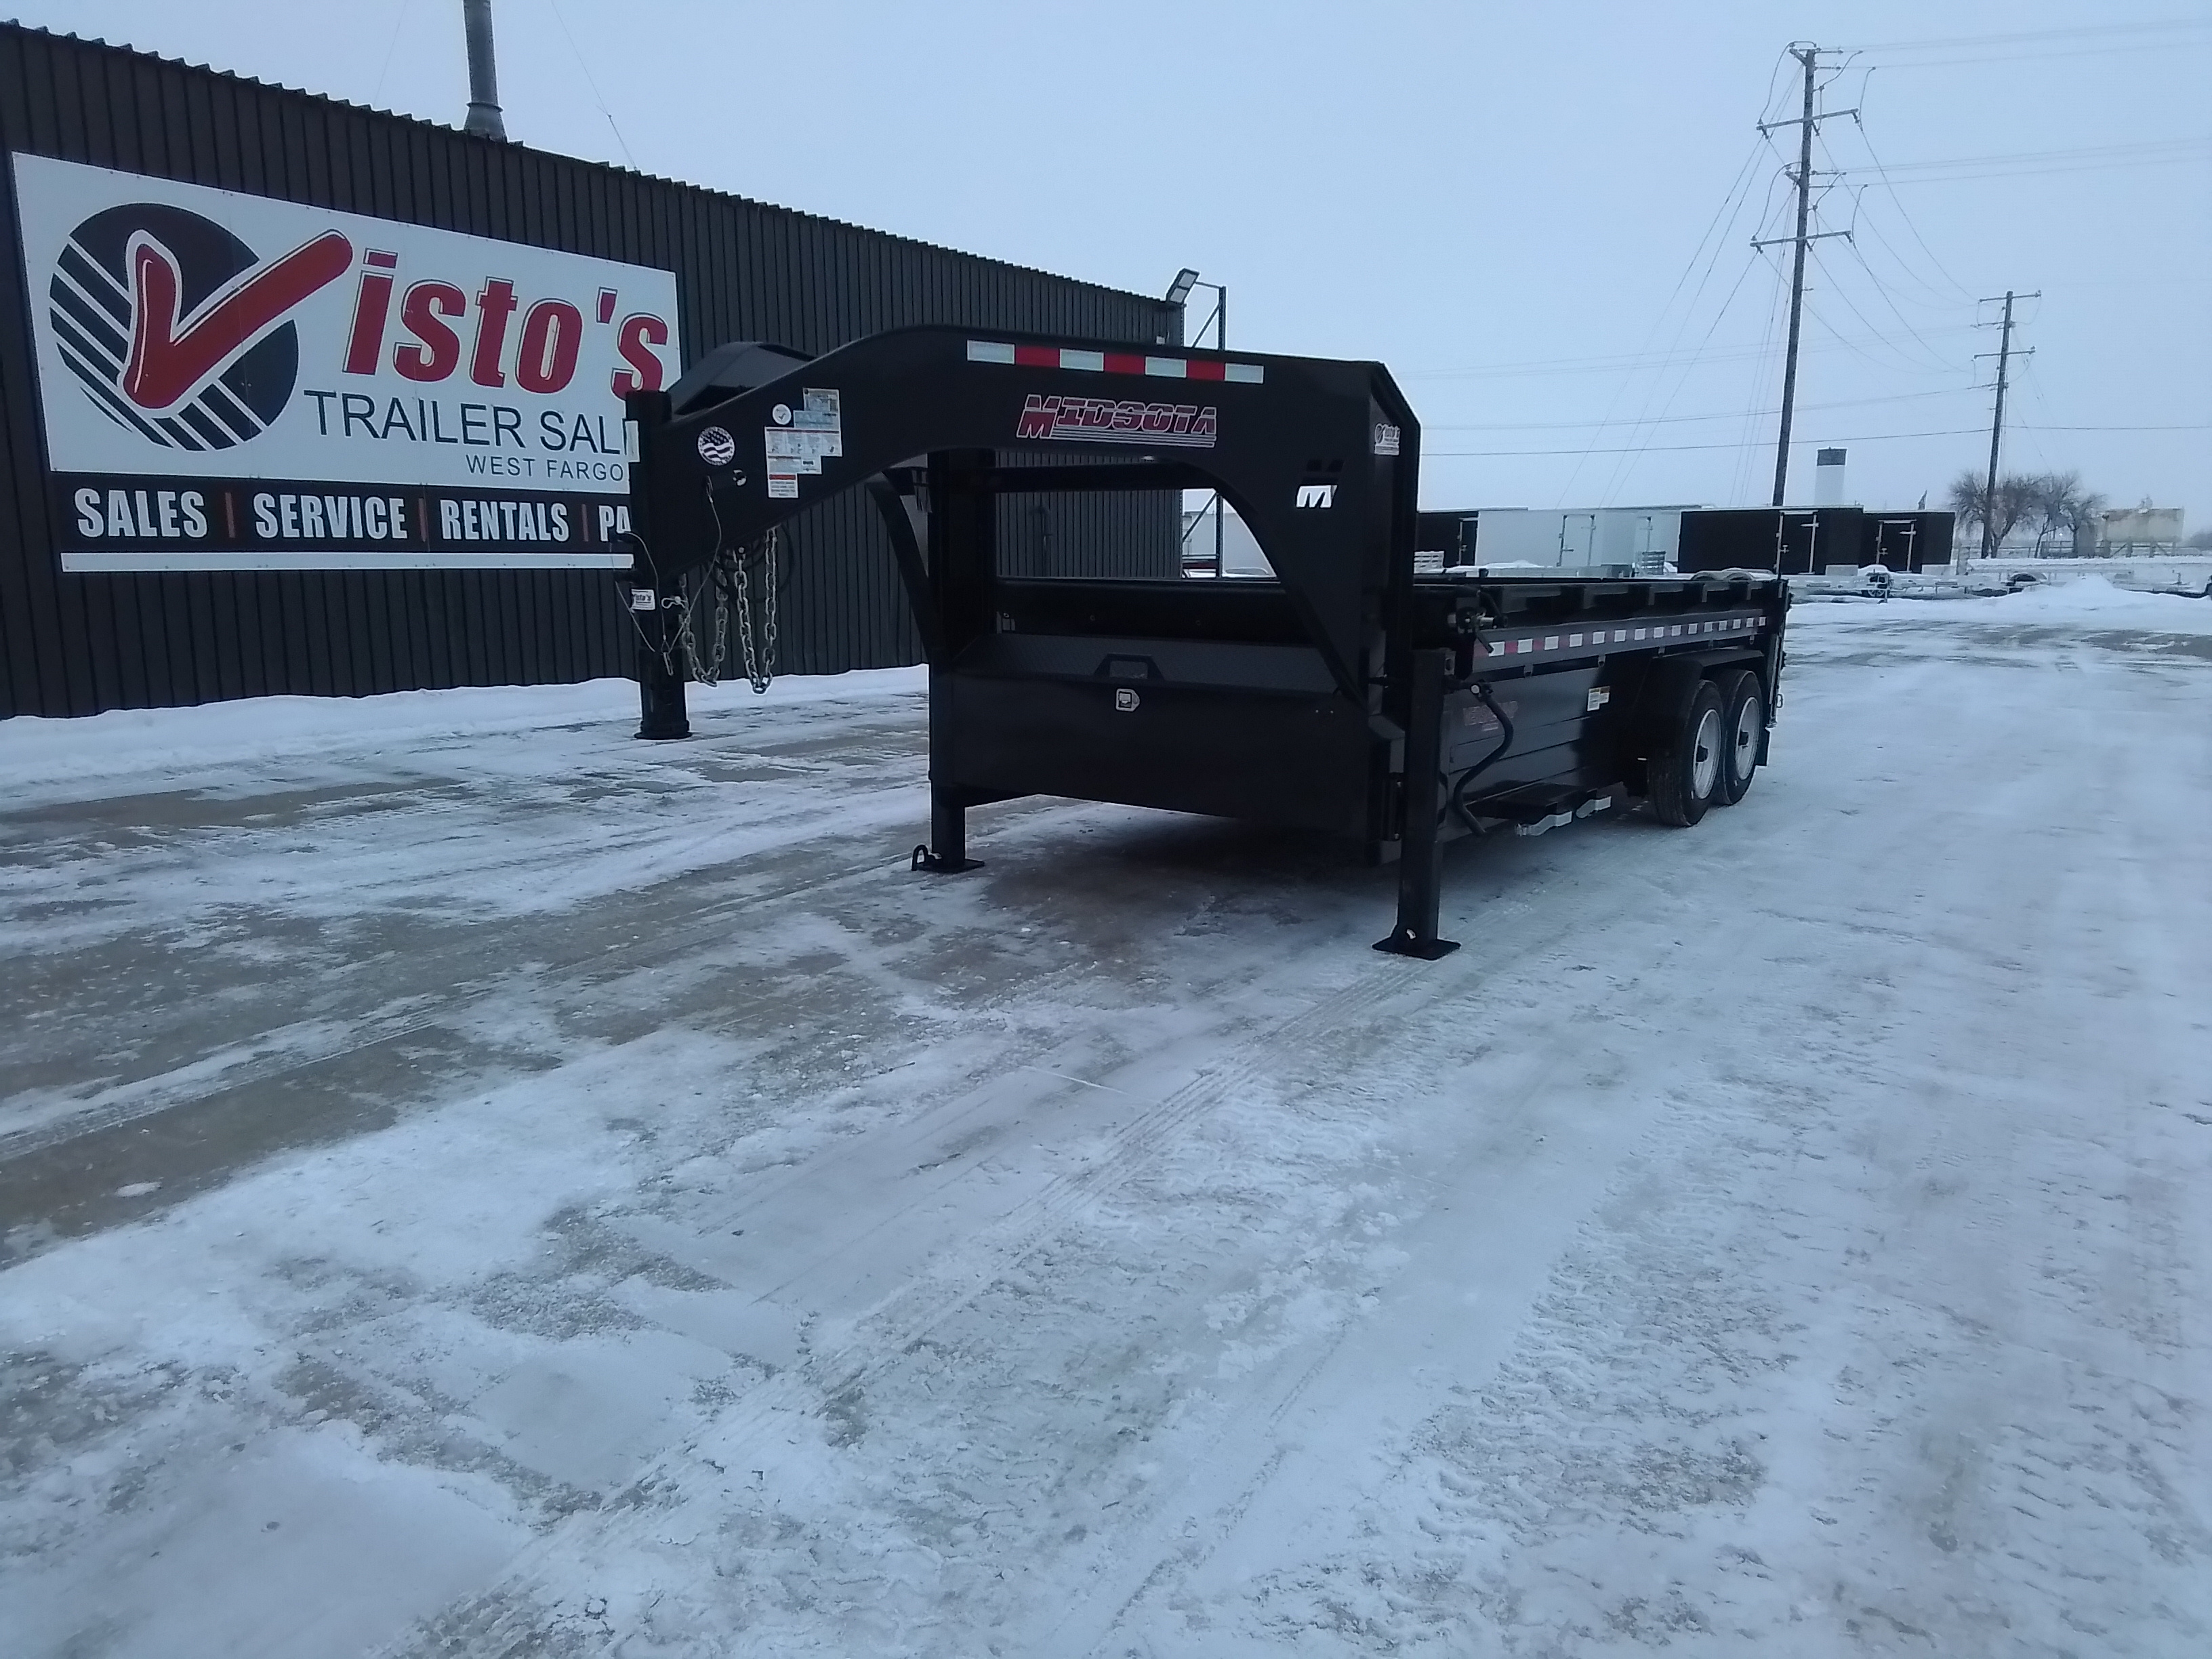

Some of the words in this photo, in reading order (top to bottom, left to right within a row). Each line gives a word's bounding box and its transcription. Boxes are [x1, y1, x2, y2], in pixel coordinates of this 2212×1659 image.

[303, 389, 526, 449] TRAILER
[1017, 394, 1217, 439] MIDSOTA
[466, 454, 536, 477] WEST
[546, 459, 624, 482] FARGO
[74, 487, 208, 539] SALES
[253, 493, 408, 539] SERVICE
[439, 499, 570, 542] RENTALS
